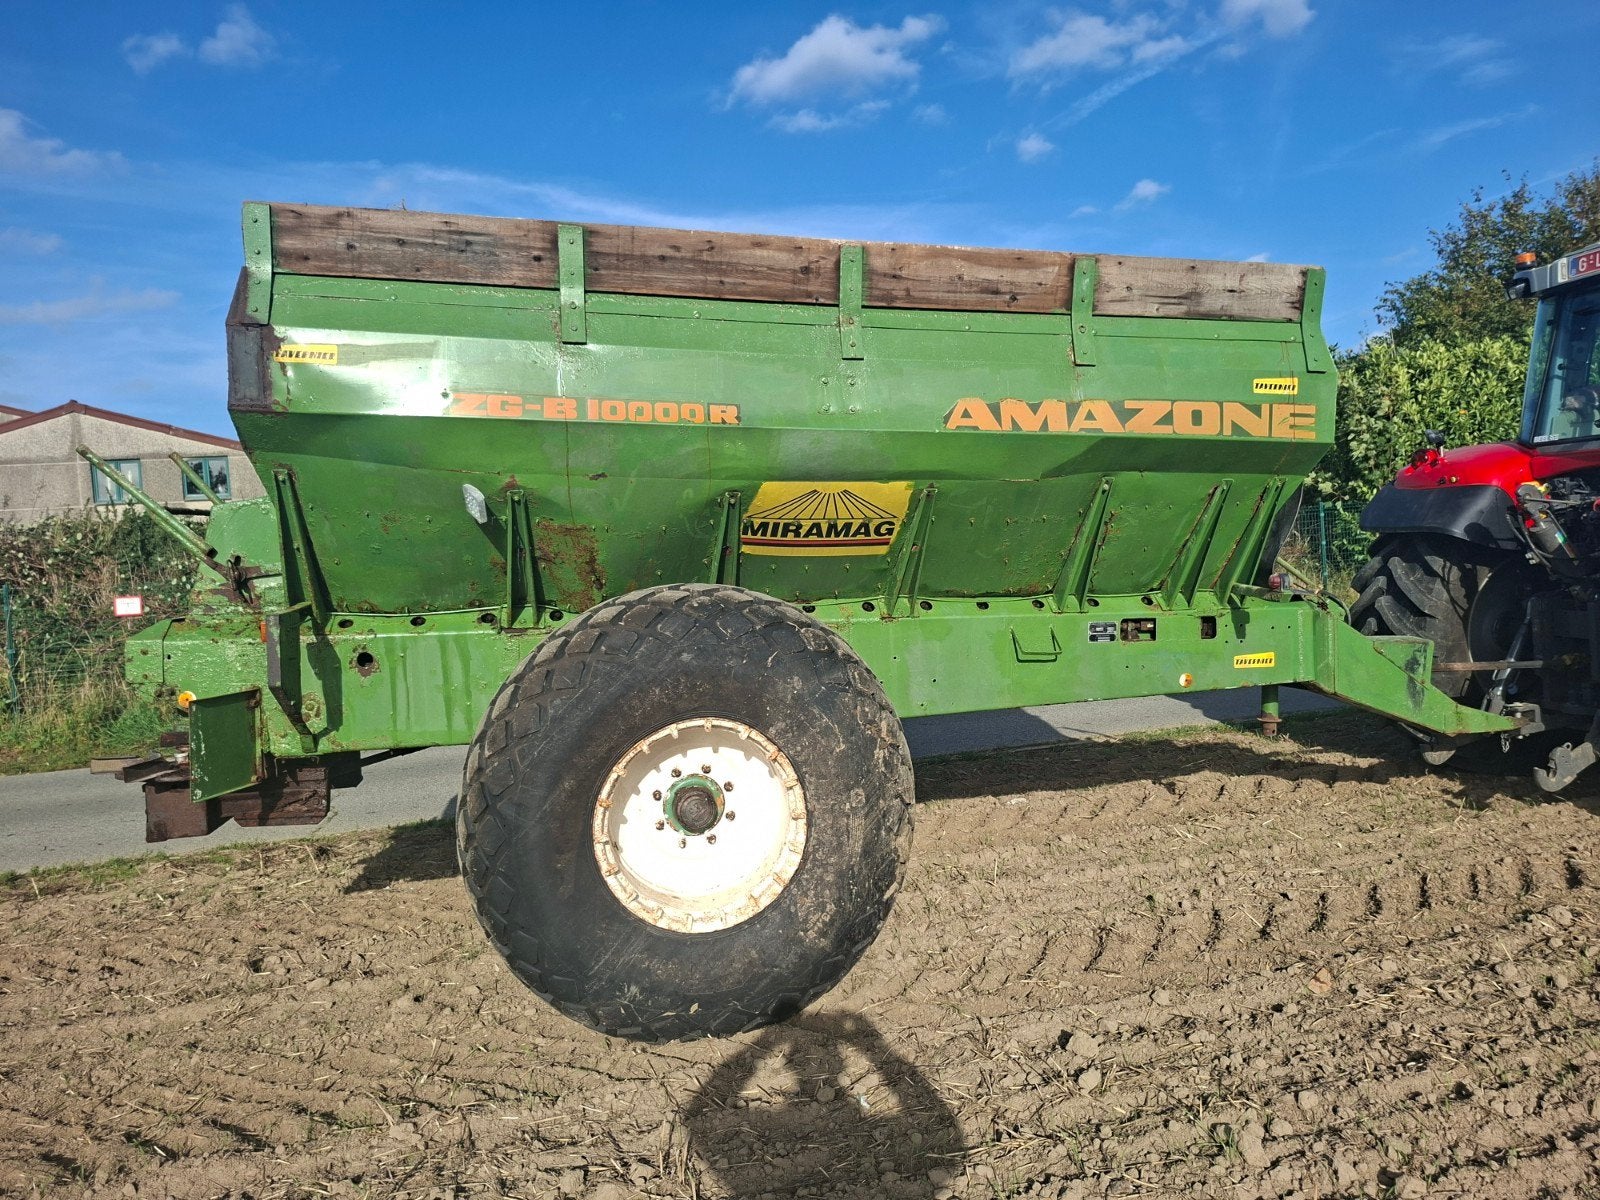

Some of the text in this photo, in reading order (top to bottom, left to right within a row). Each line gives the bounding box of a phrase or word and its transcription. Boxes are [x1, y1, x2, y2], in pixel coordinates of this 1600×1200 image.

[451, 393, 578, 420] ZG-B
[946, 398, 1316, 439] AMAZONE
[741, 520, 896, 539] MIRAMAG
